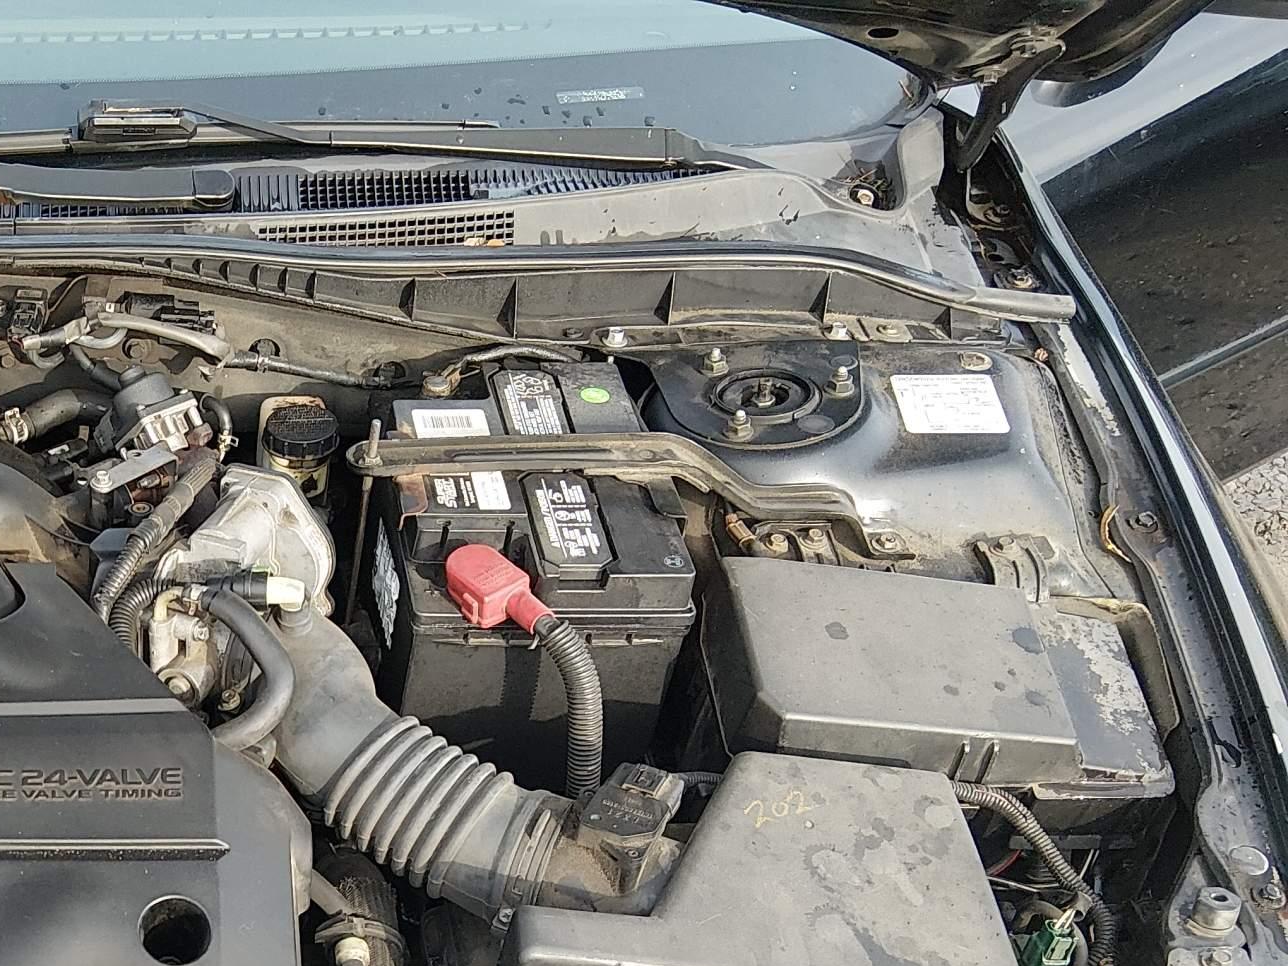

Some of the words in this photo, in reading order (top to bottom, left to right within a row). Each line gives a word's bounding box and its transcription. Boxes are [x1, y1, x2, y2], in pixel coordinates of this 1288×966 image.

[20, 767, 183, 786] 24-VALVE
[21, 788, 92, 800] VALVE
[99, 788, 183, 799] TIMING
